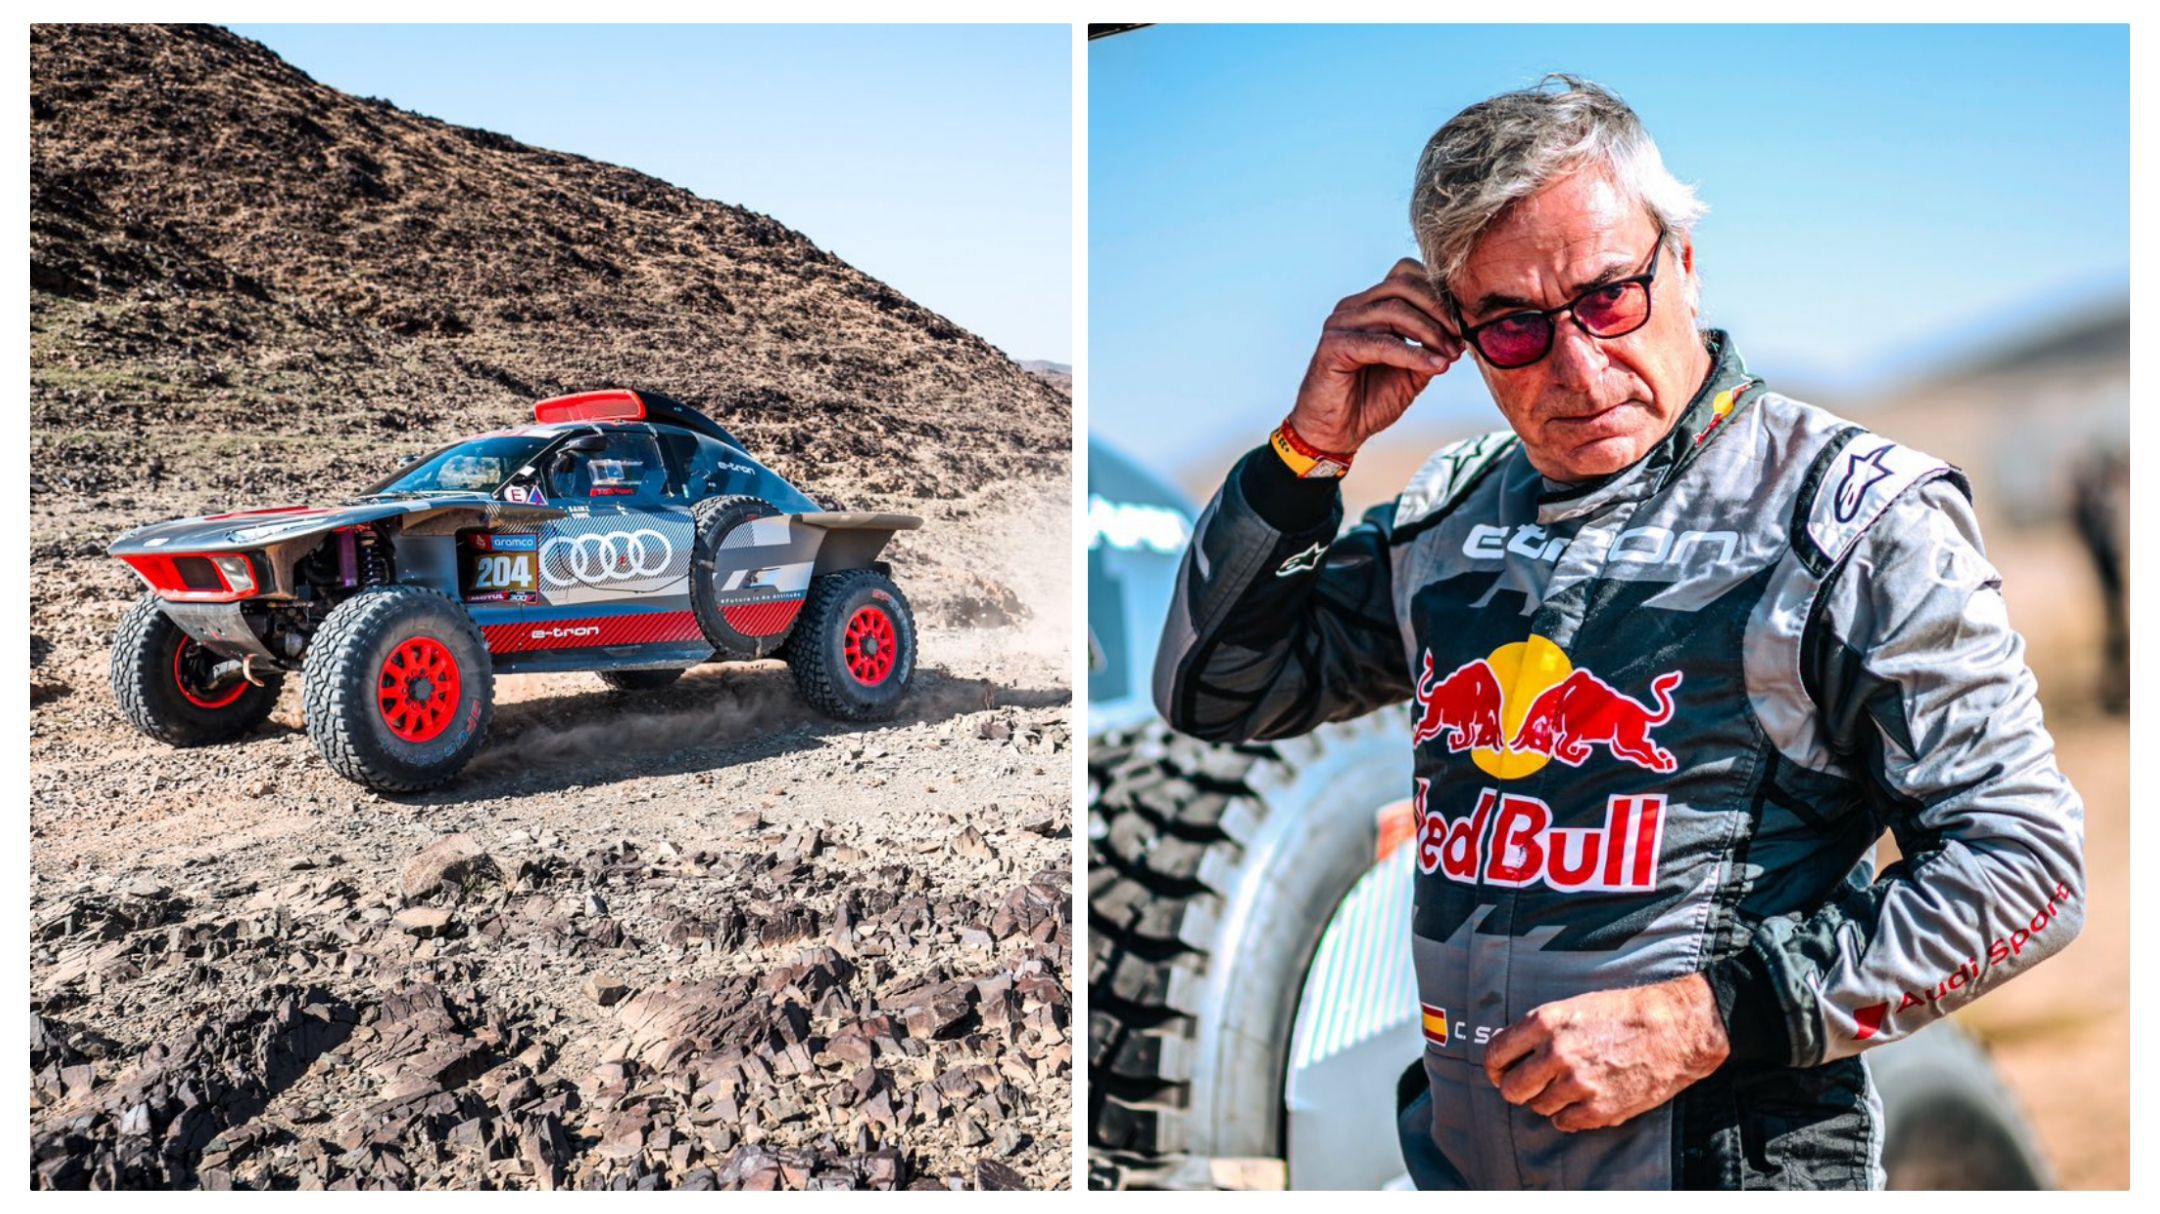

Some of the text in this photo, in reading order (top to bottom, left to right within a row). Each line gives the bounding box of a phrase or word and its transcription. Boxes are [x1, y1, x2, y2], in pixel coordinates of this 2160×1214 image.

[717, 461, 755, 475] e-tron
[511, 489, 522, 502] E
[476, 556, 532, 588] 204
[531, 626, 599, 639] e-tron
[1483, 793, 1668, 892] Bull
[1896, 882, 2071, 1014] Audi Sport
